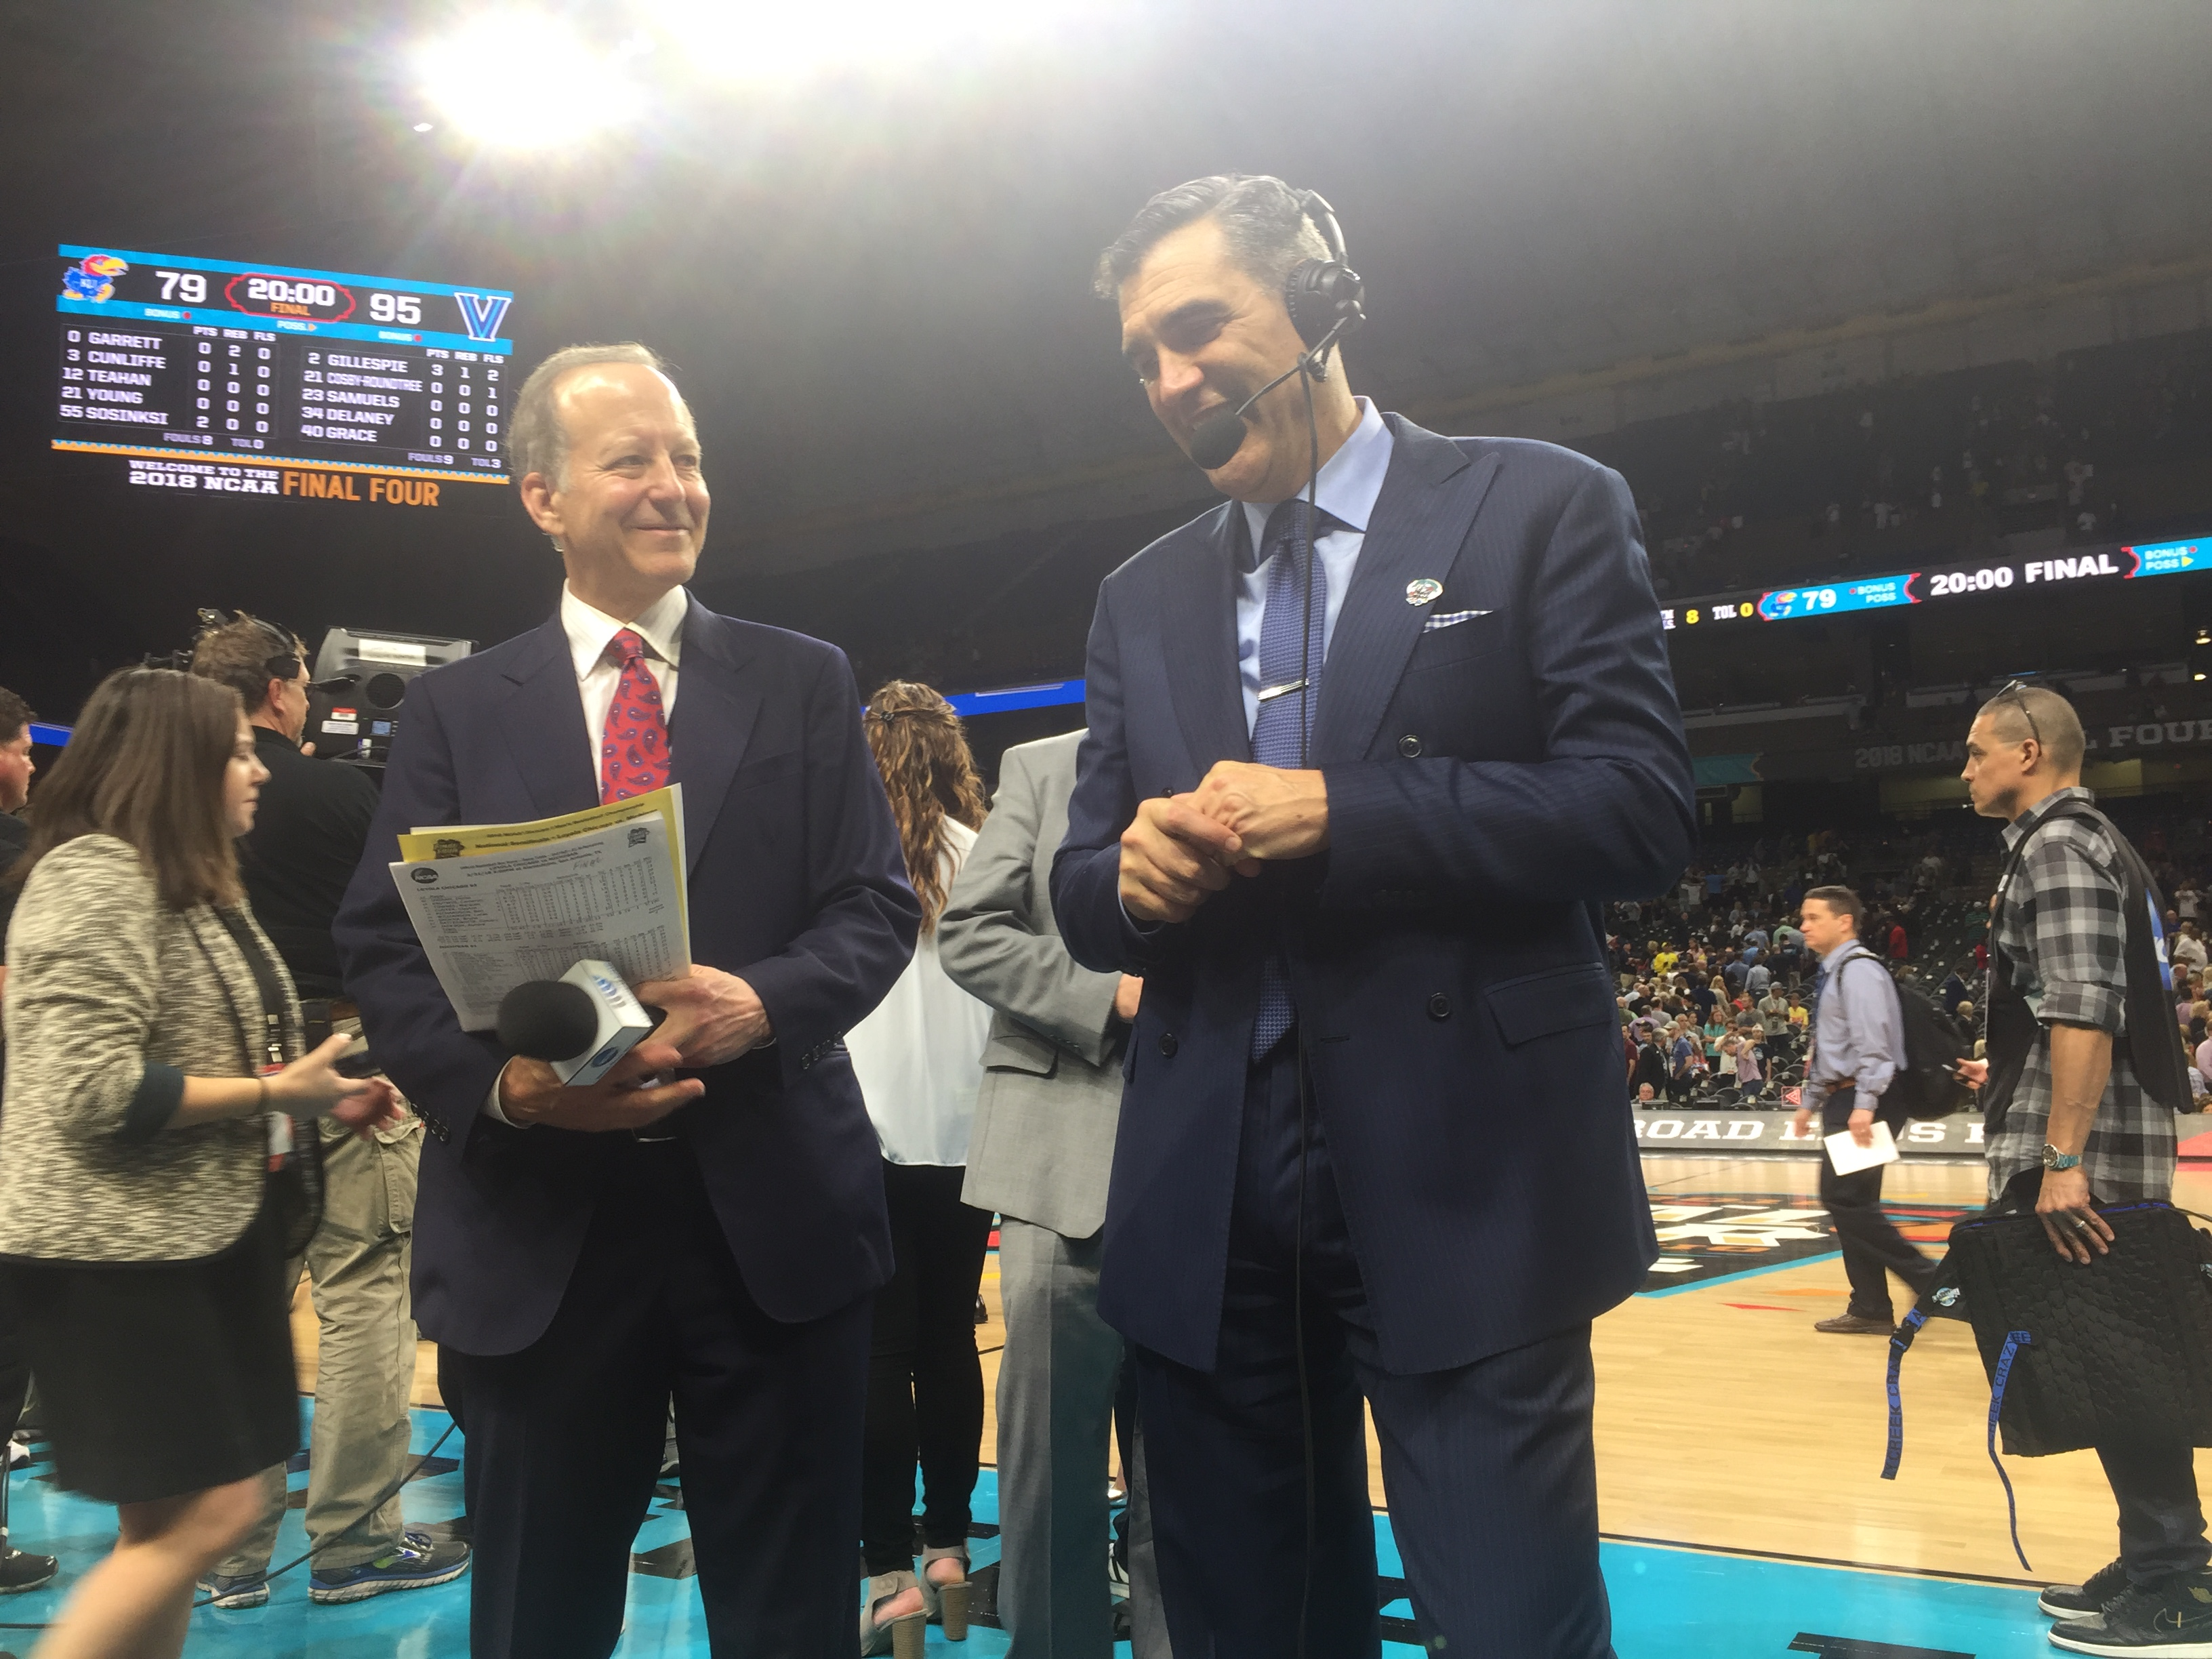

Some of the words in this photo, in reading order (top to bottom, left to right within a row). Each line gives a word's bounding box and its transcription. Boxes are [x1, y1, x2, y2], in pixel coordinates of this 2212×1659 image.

[155, 270, 207, 303] 79
[248, 278, 335, 306] 20:00
[144, 308, 180, 319] BONUS
[270, 302, 311, 316] FINAL
[369, 293, 422, 325] 95
[67, 330, 81, 342] 0
[88, 332, 163, 350] GARRETT
[198, 342, 211, 354] 0
[228, 345, 241, 357] 2
[258, 348, 270, 360] 0
[192, 326, 218, 337] PTS
[223, 329, 248, 340] REB
[253, 331, 276, 342] FLS
[67, 349, 80, 361] 3
[87, 350, 166, 369] CUNLIFFE
[197, 361, 211, 373] 0
[230, 363, 239, 375] 1
[257, 366, 270, 378] 0
[308, 352, 321, 365] 2
[327, 354, 409, 373] GILLESPIE
[431, 365, 443, 376] 3
[461, 367, 470, 378] 1
[487, 369, 499, 381] 2
[426, 348, 450, 359] PTS
[454, 350, 478, 362] REB
[483, 354, 504, 365] FLS
[62, 367, 83, 380] 12
[87, 369, 152, 386] TEAHAN
[197, 379, 210, 391] 0
[227, 382, 240, 394] 0
[257, 384, 270, 396] 0
[304, 370, 323, 383] 21
[430, 382, 443, 394] 0
[459, 384, 471, 396] 0
[488, 387, 497, 398] 1
[62, 386, 83, 399] 21
[86, 388, 143, 404] YOUNG
[197, 397, 210, 409] 0
[226, 400, 239, 412] 0
[256, 403, 270, 415] 0
[302, 388, 324, 401] 23
[326, 390, 401, 408] SAMUELS
[430, 400, 443, 412] 0
[458, 402, 470, 414] 0
[486, 405, 499, 417] 0
[60, 405, 83, 418] 55
[85, 407, 169, 425] SOSINKSI
[197, 416, 209, 428] 2
[226, 418, 239, 430] 0
[255, 421, 269, 433] 0
[302, 407, 324, 419] 34
[326, 408, 395, 426] DELANEY
[430, 417, 443, 430] 0
[457, 419, 470, 432] 0
[486, 422, 498, 434] 0
[300, 424, 324, 437] 40
[325, 427, 377, 443] GRACE
[429, 435, 442, 447] 0
[457, 438, 470, 449] 0
[485, 440, 497, 452] 0
[128, 459, 216, 474] WELCOME
[218, 466, 241, 476] TO
[243, 468, 279, 480] THE
[129, 471, 197, 488] 2018
[203, 476, 279, 494] NCAA
[283, 471, 361, 501] FINAL
[369, 477, 440, 507] FOUR
[2144, 546, 2188, 560] BONUS
[2145, 558, 2179, 571] POSS
[1857, 582, 1896, 595] BONUS
[1930, 566, 2013, 596] 20:00
[2025, 554, 2119, 583] FINAL
[1802, 588, 1837, 611] 79
[1866, 592, 1896, 603] POSS
[1686, 609, 1700, 624] 8
[1712, 605, 1738, 620] TOL
[1740, 602, 1754, 617] 0
[1854, 746, 1902, 769] 2018
[1907, 741, 1964, 764] NCAA
